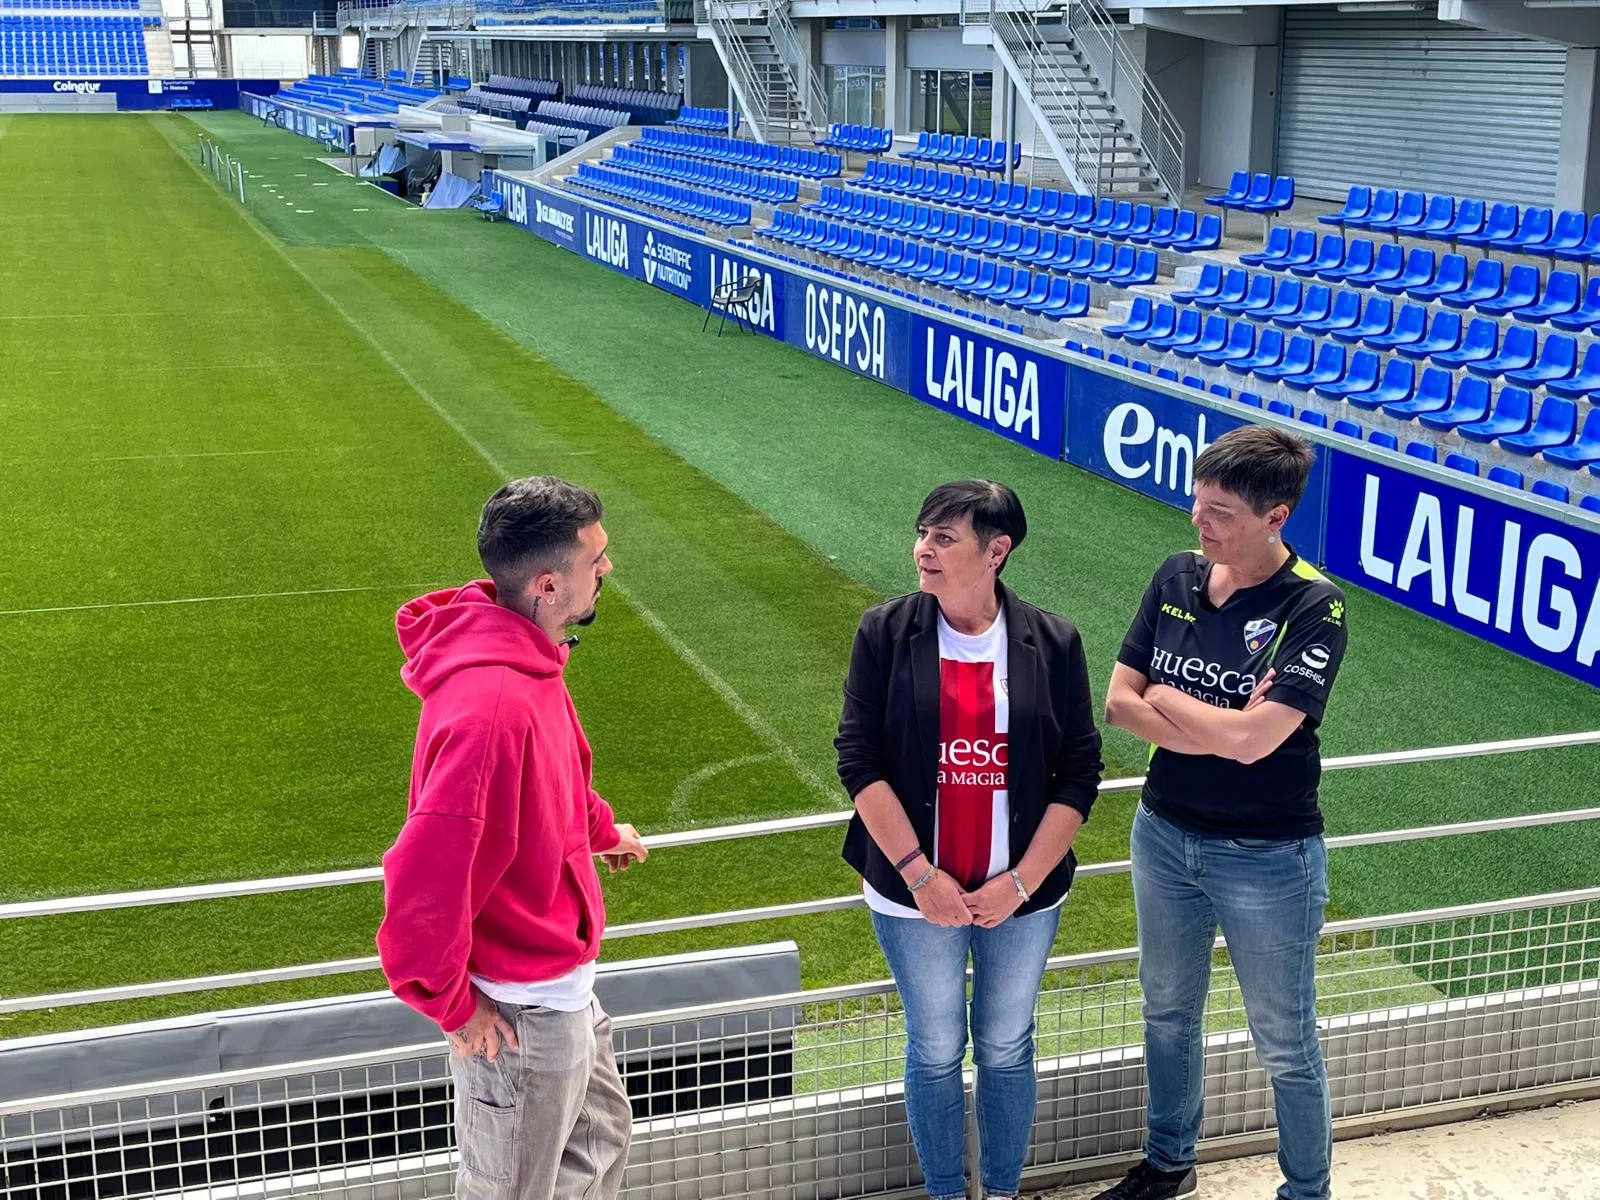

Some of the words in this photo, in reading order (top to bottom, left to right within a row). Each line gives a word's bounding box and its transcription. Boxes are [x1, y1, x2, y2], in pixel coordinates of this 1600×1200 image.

[586, 211, 629, 270] LALIGA
[805, 283, 886, 379] OSEPSA
[926, 326, 1040, 441] LALIGA
[1150, 646, 1257, 695] Huesca
[1283, 664, 1326, 687] COSEHISA
